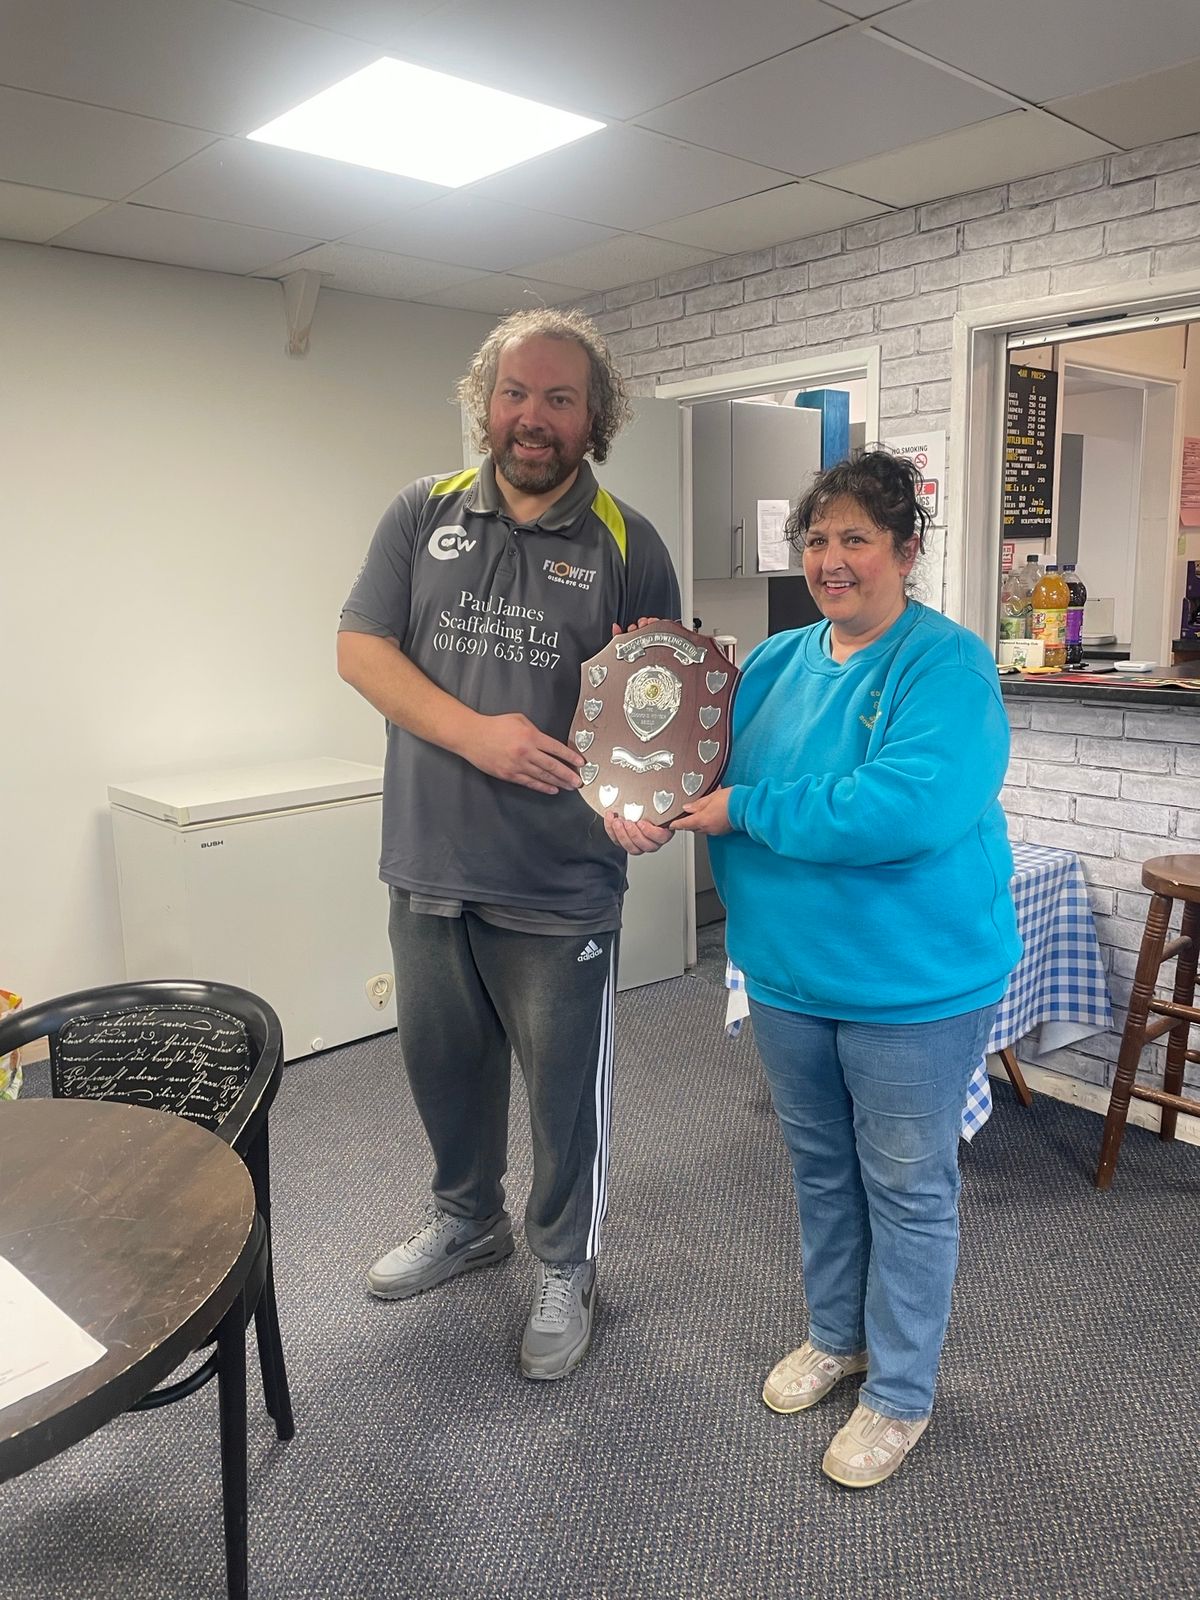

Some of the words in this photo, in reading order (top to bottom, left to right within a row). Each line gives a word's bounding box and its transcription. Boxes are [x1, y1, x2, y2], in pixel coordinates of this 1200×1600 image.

[902, 445, 928, 454] SMOKING
[543, 560, 596, 582] FLOWFIT
[458, 590, 492, 612] Paul
[492, 596, 544, 622] James
[440, 610, 524, 644] Scaffolding
[528, 626, 558, 648] Ltd
[494, 642, 524, 662] 655
[530, 649, 560, 670] 297
[654, 634, 682, 647] BOWLING
[682, 642, 698, 656] CLUB
[578, 948, 602, 962] adidas
